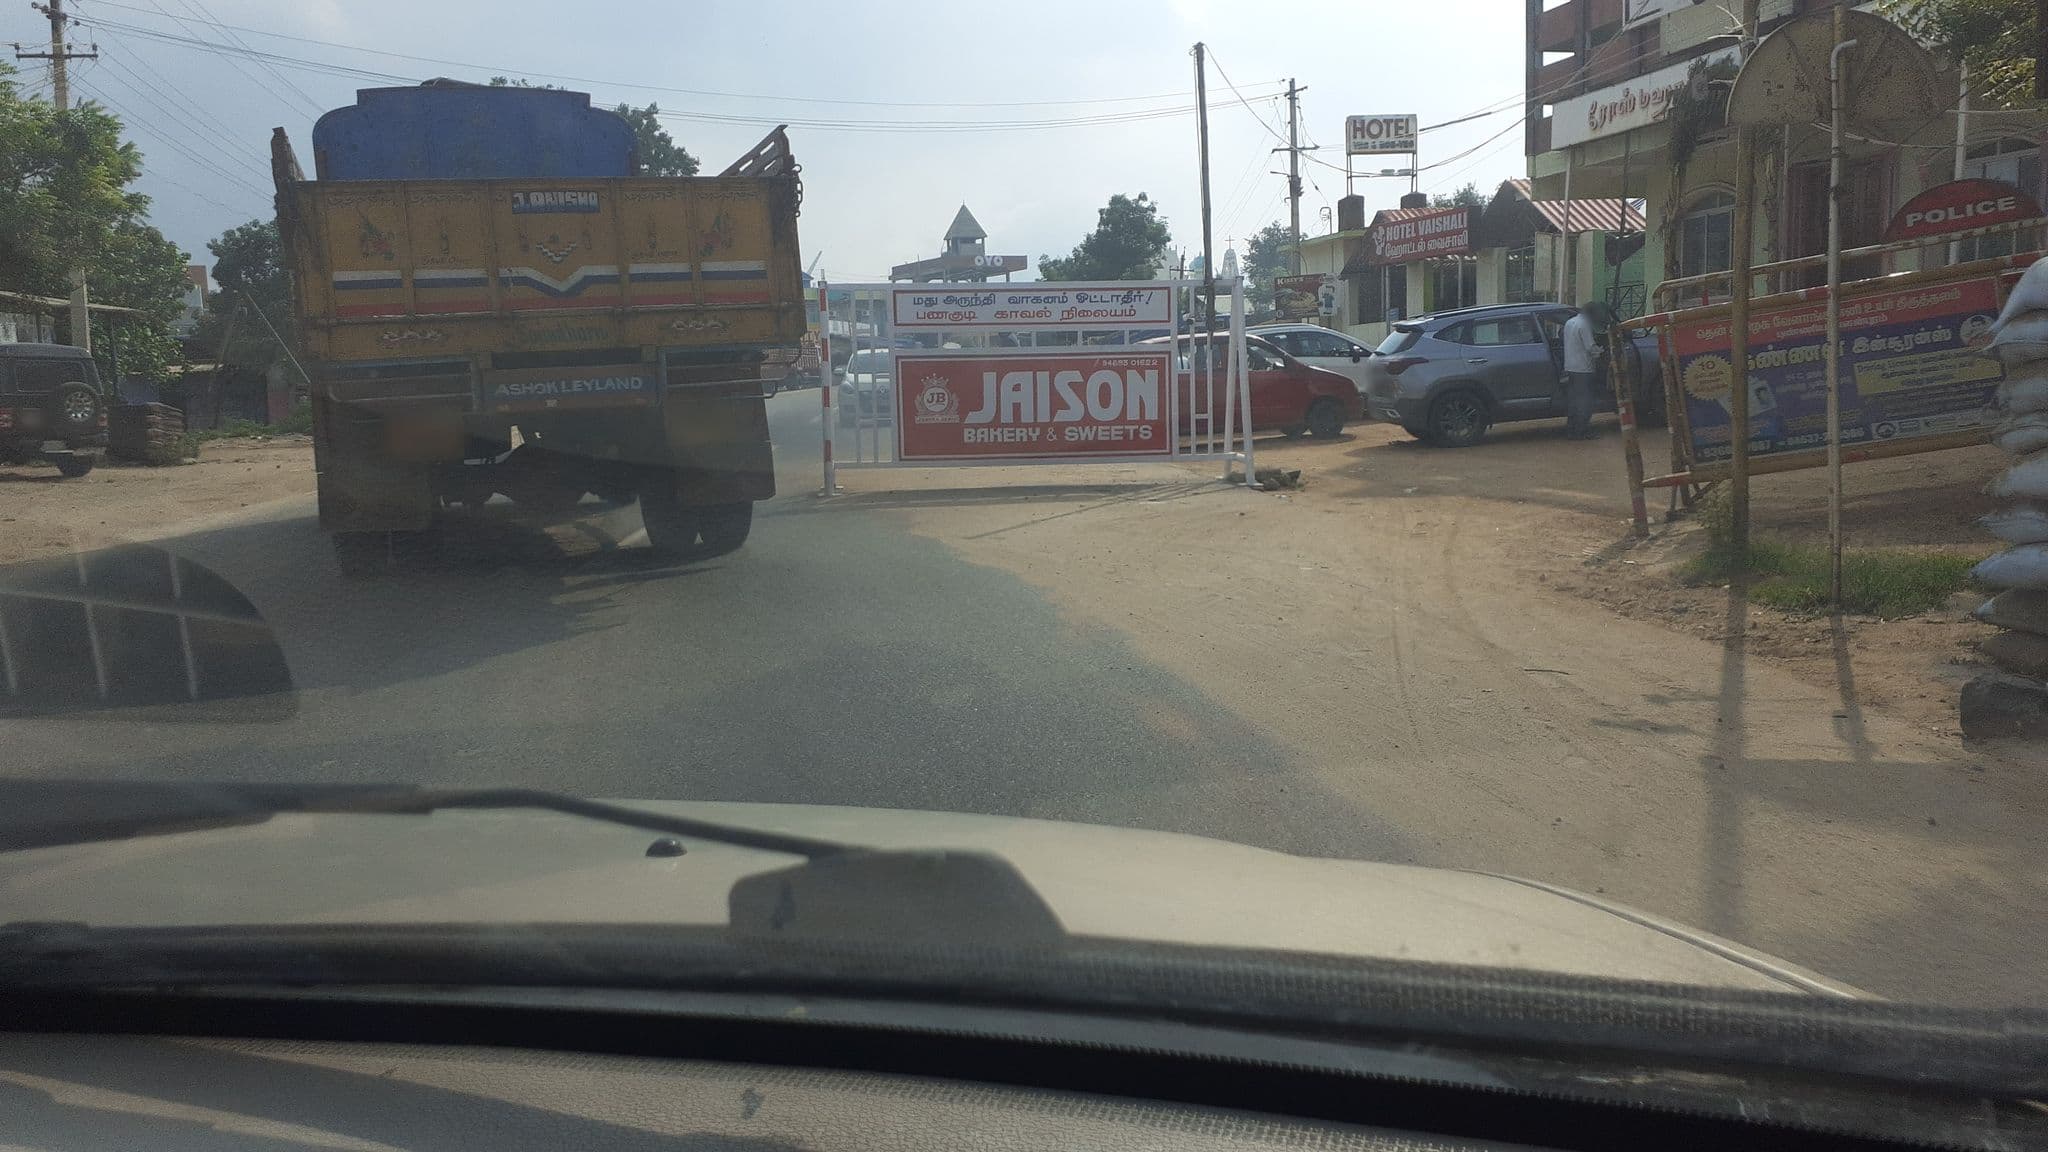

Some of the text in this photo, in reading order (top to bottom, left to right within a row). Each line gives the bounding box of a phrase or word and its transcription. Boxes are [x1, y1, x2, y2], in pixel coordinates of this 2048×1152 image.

[1352, 118, 1413, 139] HOTEL
[1906, 196, 2017, 227] POLICE
[1386, 212, 1468, 241] HOTEL VAISHALI
[1385, 239, 1426, 259] ஹோட்டல்
[974, 255, 1003, 266] OYO
[913, 296, 938, 307] மது
[943, 293, 996, 307] அருந்தி
[1007, 292, 1068, 305] வாகனம்
[916, 305, 1136, 321] பணகுடி காவல் நிலையம்
[495, 376, 643, 396] ASHOK LEYLAND
[926, 393, 946, 404] JB
[963, 369, 1159, 424] JAISON
[963, 425, 1153, 443] BAKERY & SWEETS
